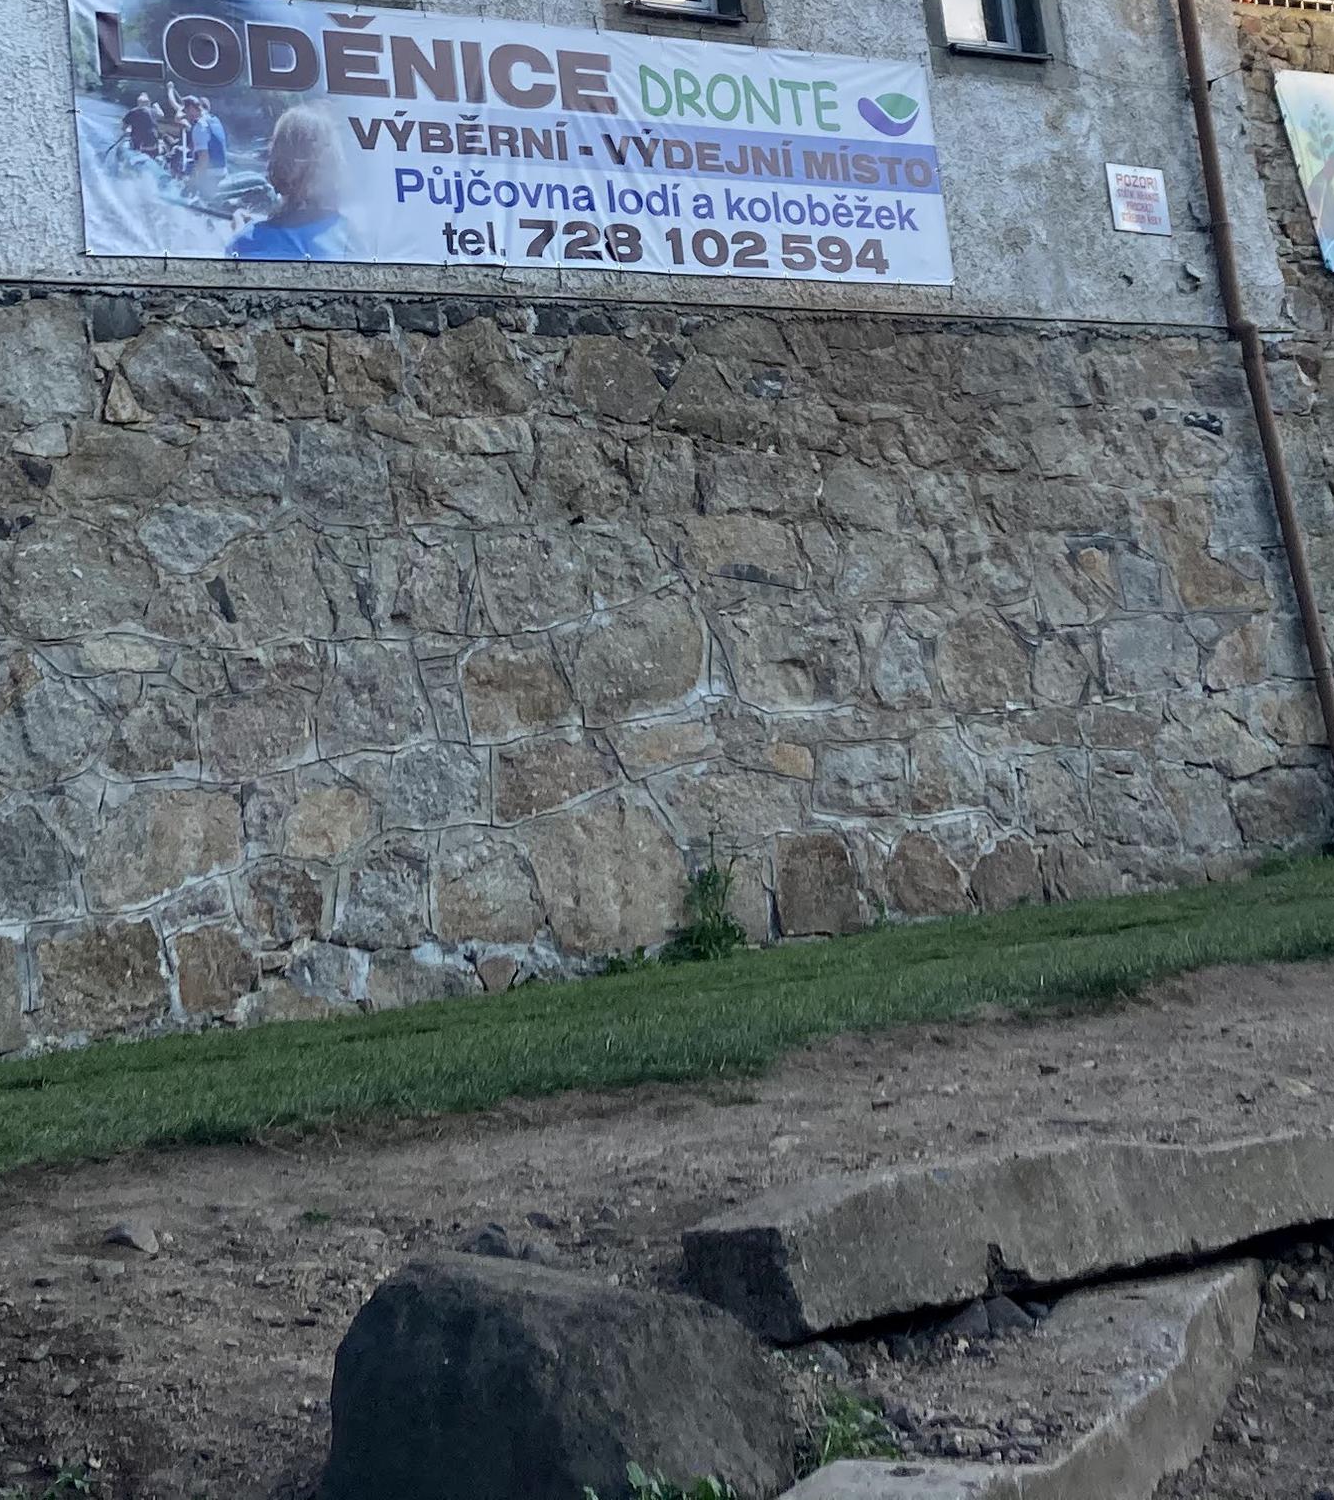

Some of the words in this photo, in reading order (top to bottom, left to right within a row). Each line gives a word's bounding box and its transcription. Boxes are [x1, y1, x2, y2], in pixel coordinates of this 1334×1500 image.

[94, 11, 619, 115] LODĚNICE
[638, 64, 841, 132] DRONTE
[348, 110, 569, 161] VÝBĚRNÍ
[578, 145, 594, 157] -
[601, 128, 794, 178] VÝDEJNÍ
[802, 145, 933, 188] MÍSTO
[394, 166, 597, 214] Půjčovna
[607, 179, 681, 218] lodí
[692, 193, 715, 219] a
[724, 188, 920, 232] koloběžek
[442, 221, 507, 257] tel.
[518, 218, 644, 263] 728
[665, 227, 770, 269] 102
[780, 233, 890, 275] 594
